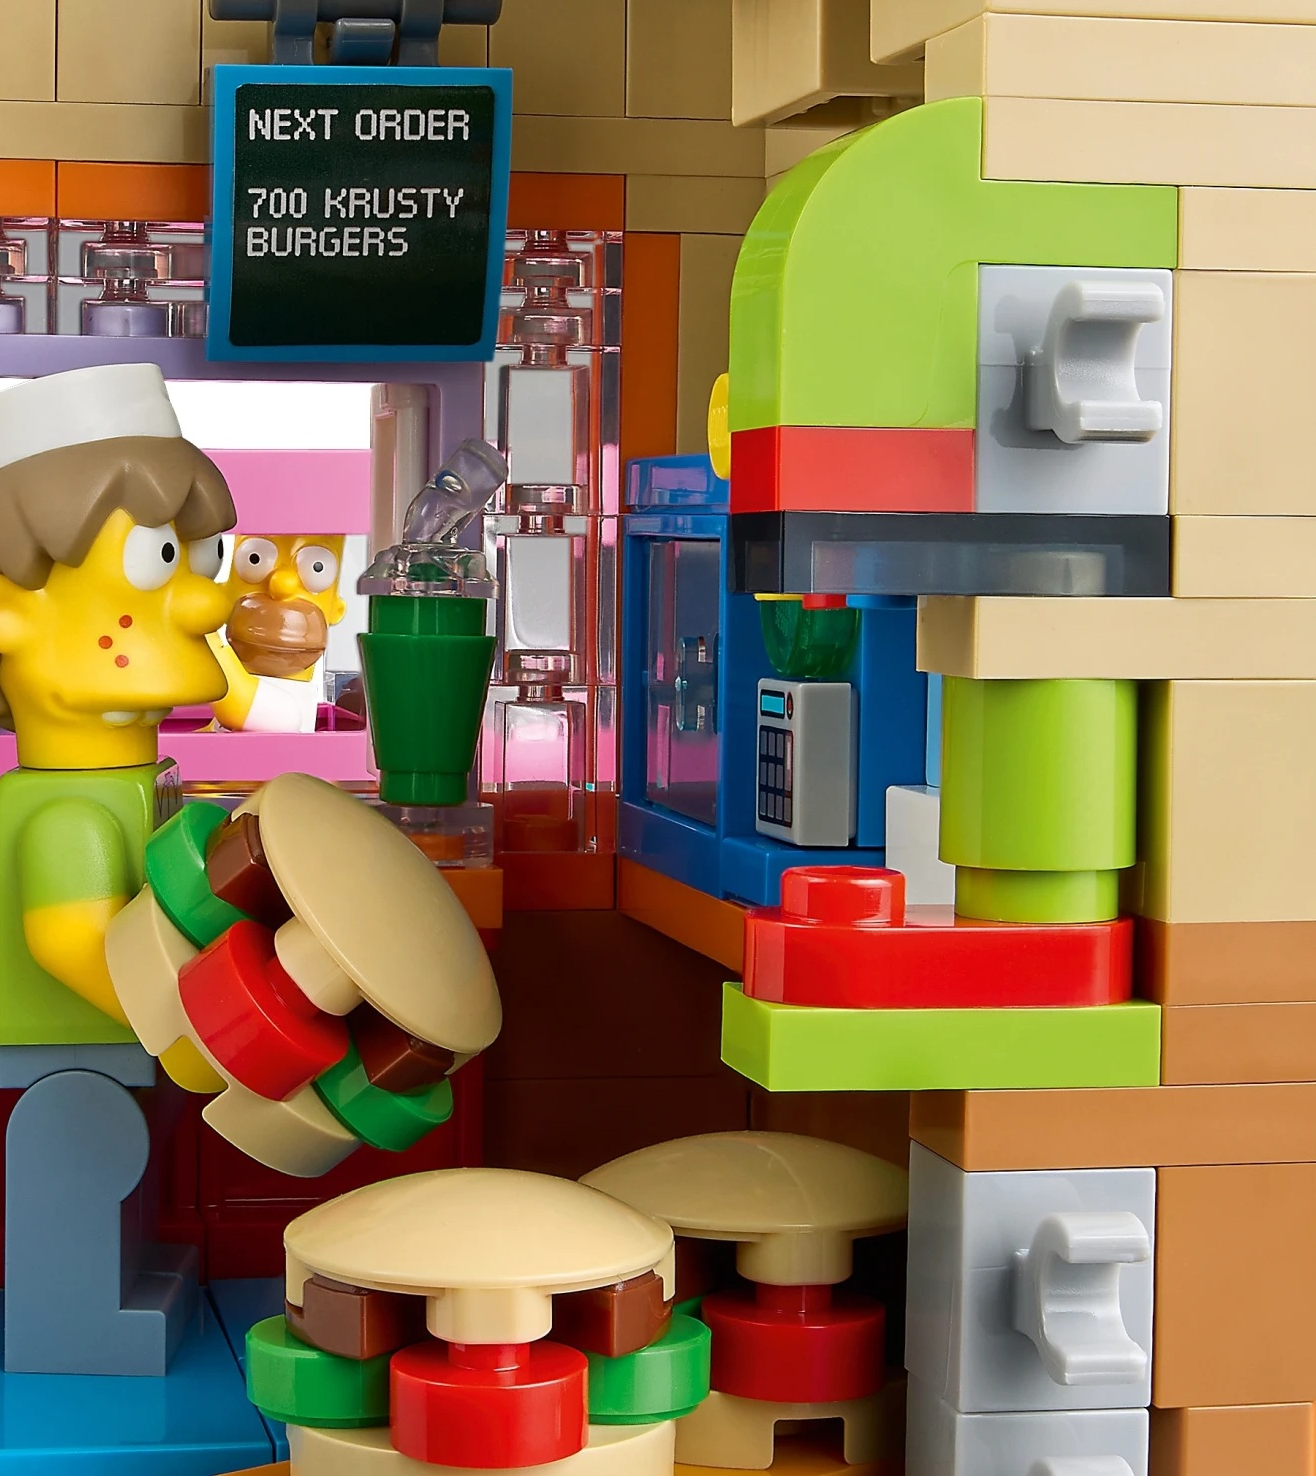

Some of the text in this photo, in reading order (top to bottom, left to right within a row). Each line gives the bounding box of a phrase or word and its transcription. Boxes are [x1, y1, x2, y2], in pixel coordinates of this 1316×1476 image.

[249, 109, 470, 141] NEXT ORDER
[247, 188, 464, 219] 700 KRUSTY
[247, 227, 409, 257] BURGERS
